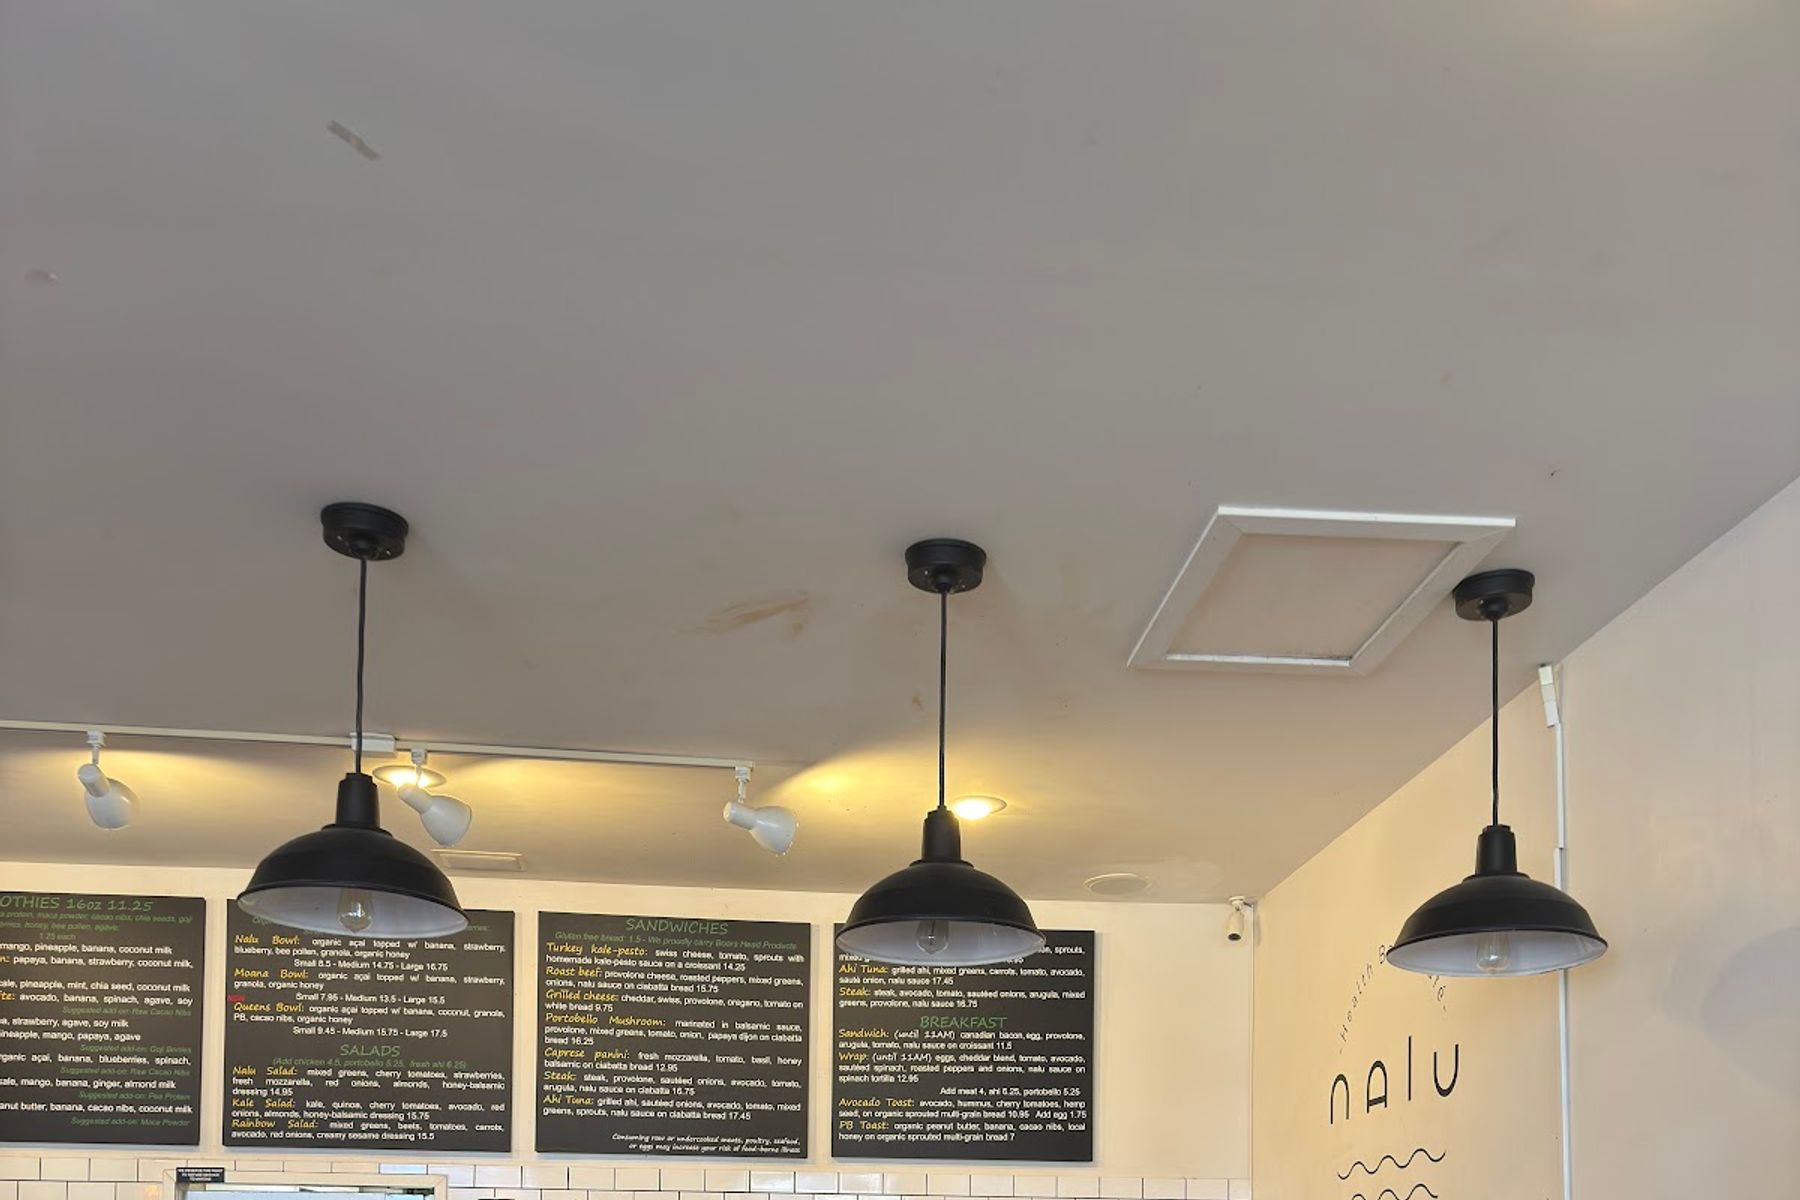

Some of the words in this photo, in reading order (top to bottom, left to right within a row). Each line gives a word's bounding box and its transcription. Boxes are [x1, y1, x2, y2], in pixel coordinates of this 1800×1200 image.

[66, 899, 102, 910] 16oz
[109, 901, 153, 911] 11.25
[625, 919, 729, 935] SANDWICHES
[34, 943, 79, 954] pineapple,
[81, 944, 116, 954] banana,
[118, 944, 153, 954] coconut
[154, 945, 173, 954] milk
[234, 934, 259, 944] Nalu
[272, 935, 300, 945] Bowl:
[311, 938, 341, 948] organic
[372, 939, 400, 950] topped
[424, 941, 456, 951] banana,
[462, 942, 506, 953] strawberry,
[234, 945, 273, 956] blueberry,
[274, 946, 290, 955] bee
[292, 947, 318, 957] pollen,
[320, 948, 352, 958] granola,
[354, 948, 384, 959] organic
[385, 949, 410, 960] honey
[547, 943, 583, 955] Turkey
[591, 943, 648, 956] kale-pesto:
[655, 948, 677, 957] swiss
[682, 949, 714, 960] cheese,
[718, 951, 749, 961] tomato,
[753, 952, 783, 963] sprouts
[788, 954, 804, 963] with
[13, 957, 48, 967] papaya,
[50, 956, 86, 967] banana,
[87, 957, 135, 969] strawberry,
[136, 958, 171, 968] coconut
[173, 959, 193, 969] milk,
[294, 959, 316, 968] Small
[318, 959, 331, 968] 8.5
[337, 960, 370, 969] Medium
[371, 961, 394, 970] 14.75
[400, 962, 424, 972] Large
[425, 962, 448, 971] 16.75
[546, 967, 575, 976] Roast
[578, 968, 603, 978] beef:
[838, 965, 857, 974] Ahi
[860, 965, 888, 974] Tuna:
[234, 969, 269, 978] Moana
[280, 969, 308, 979] Bowl:
[318, 972, 348, 982] organic
[376, 973, 404, 984] topped
[424, 974, 457, 984] banana,
[462, 975, 505, 986] strawberry,
[862, 976, 886, 985] onion,
[888, 976, 905, 984] nalu
[19, 980, 65, 991] pineapple,
[67, 980, 88, 991] mint,
[90, 981, 109, 990] chia
[110, 981, 135, 992] seed,
[136, 982, 171, 992] coconut
[172, 983, 190, 992] milk
[545, 978, 575, 988] onions,
[577, 979, 595, 988] nalu
[636, 981, 668, 991] ciabatta
[670, 983, 694, 992] bread
[546, 990, 580, 1000] Grilled
[584, 991, 619, 1001] cheese:
[839, 987, 871, 996] Steak:
[19, 992, 59, 1003] avocado,
[63, 993, 99, 1004] banana,
[103, 994, 139, 1005] spinach,
[143, 997, 173, 1006] agave,
[177, 998, 193, 1006] soy
[296, 993, 319, 1002] Small
[320, 993, 338, 1002] 7.95
[344, 994, 377, 1003] Medium
[403, 995, 426, 1005] Large
[427, 996, 446, 1004] 15.5
[234, 1002, 271, 1012] Queens
[276, 1003, 304, 1012] Bowl:
[544, 1002, 566, 1010] white
[569, 1002, 592, 1011] bread
[545, 1013, 598, 1024] Portobello
[609, 1016, 666, 1026] Mushroom:
[920, 1016, 1008, 1029] BREAKFAST
[838, 1029, 889, 1038] Sandwich:
[544, 1036, 568, 1044] bread
[340, 1045, 400, 1057] SALADS
[544, 1048, 585, 1059] Caprese
[595, 1048, 630, 1060] panini:
[638, 1051, 658, 1060] fresh
[664, 1052, 710, 1062] mozzarella,
[715, 1054, 745, 1064] tomato,
[750, 1055, 772, 1064] basil,
[777, 1056, 802, 1066] honey
[839, 1052, 869, 1062] Wrap:
[232, 1066, 256, 1075] Nalu
[266, 1067, 297, 1076] Salad:
[544, 1072, 576, 1081] Steak:
[838, 1074, 868, 1084] spinach
[871, 1074, 895, 1082] tortilla
[232, 1099, 254, 1107] Kale
[264, 1100, 296, 1108] Salad:
[543, 1095, 562, 1104] Ahi
[566, 1095, 594, 1105] Tuna:
[838, 1098, 881, 1107] Avocado
[886, 1098, 914, 1107] Toast:
[920, 1098, 954, 1107] avocado,
[957, 1099, 993, 1108] hummus,
[996, 1099, 1020, 1109] cherry
[1023, 1100, 1060, 1109] tomatoes,
[1063, 1100, 1085, 1110] hemp
[1035, 1110, 1051, 1118] Add
[1053, 1112, 1068, 1120] egg
[1069, 1110, 1087, 1118] 1.75
[232, 1119, 275, 1128] Rainbow
[288, 1120, 318, 1128] Salad:
[838, 1121, 854, 1129] PB
[860, 1121, 889, 1129] Toast:
[612, 1133, 649, 1142] Consuming
[838, 1132, 862, 1142] honey
[876, 1132, 905, 1142] organic
[907, 1132, 941, 1142] sprouted
[943, 1132, 983, 1142] multi-grain
[985, 1133, 1008, 1141] bread
[1010, 1133, 1015, 1141] 7
